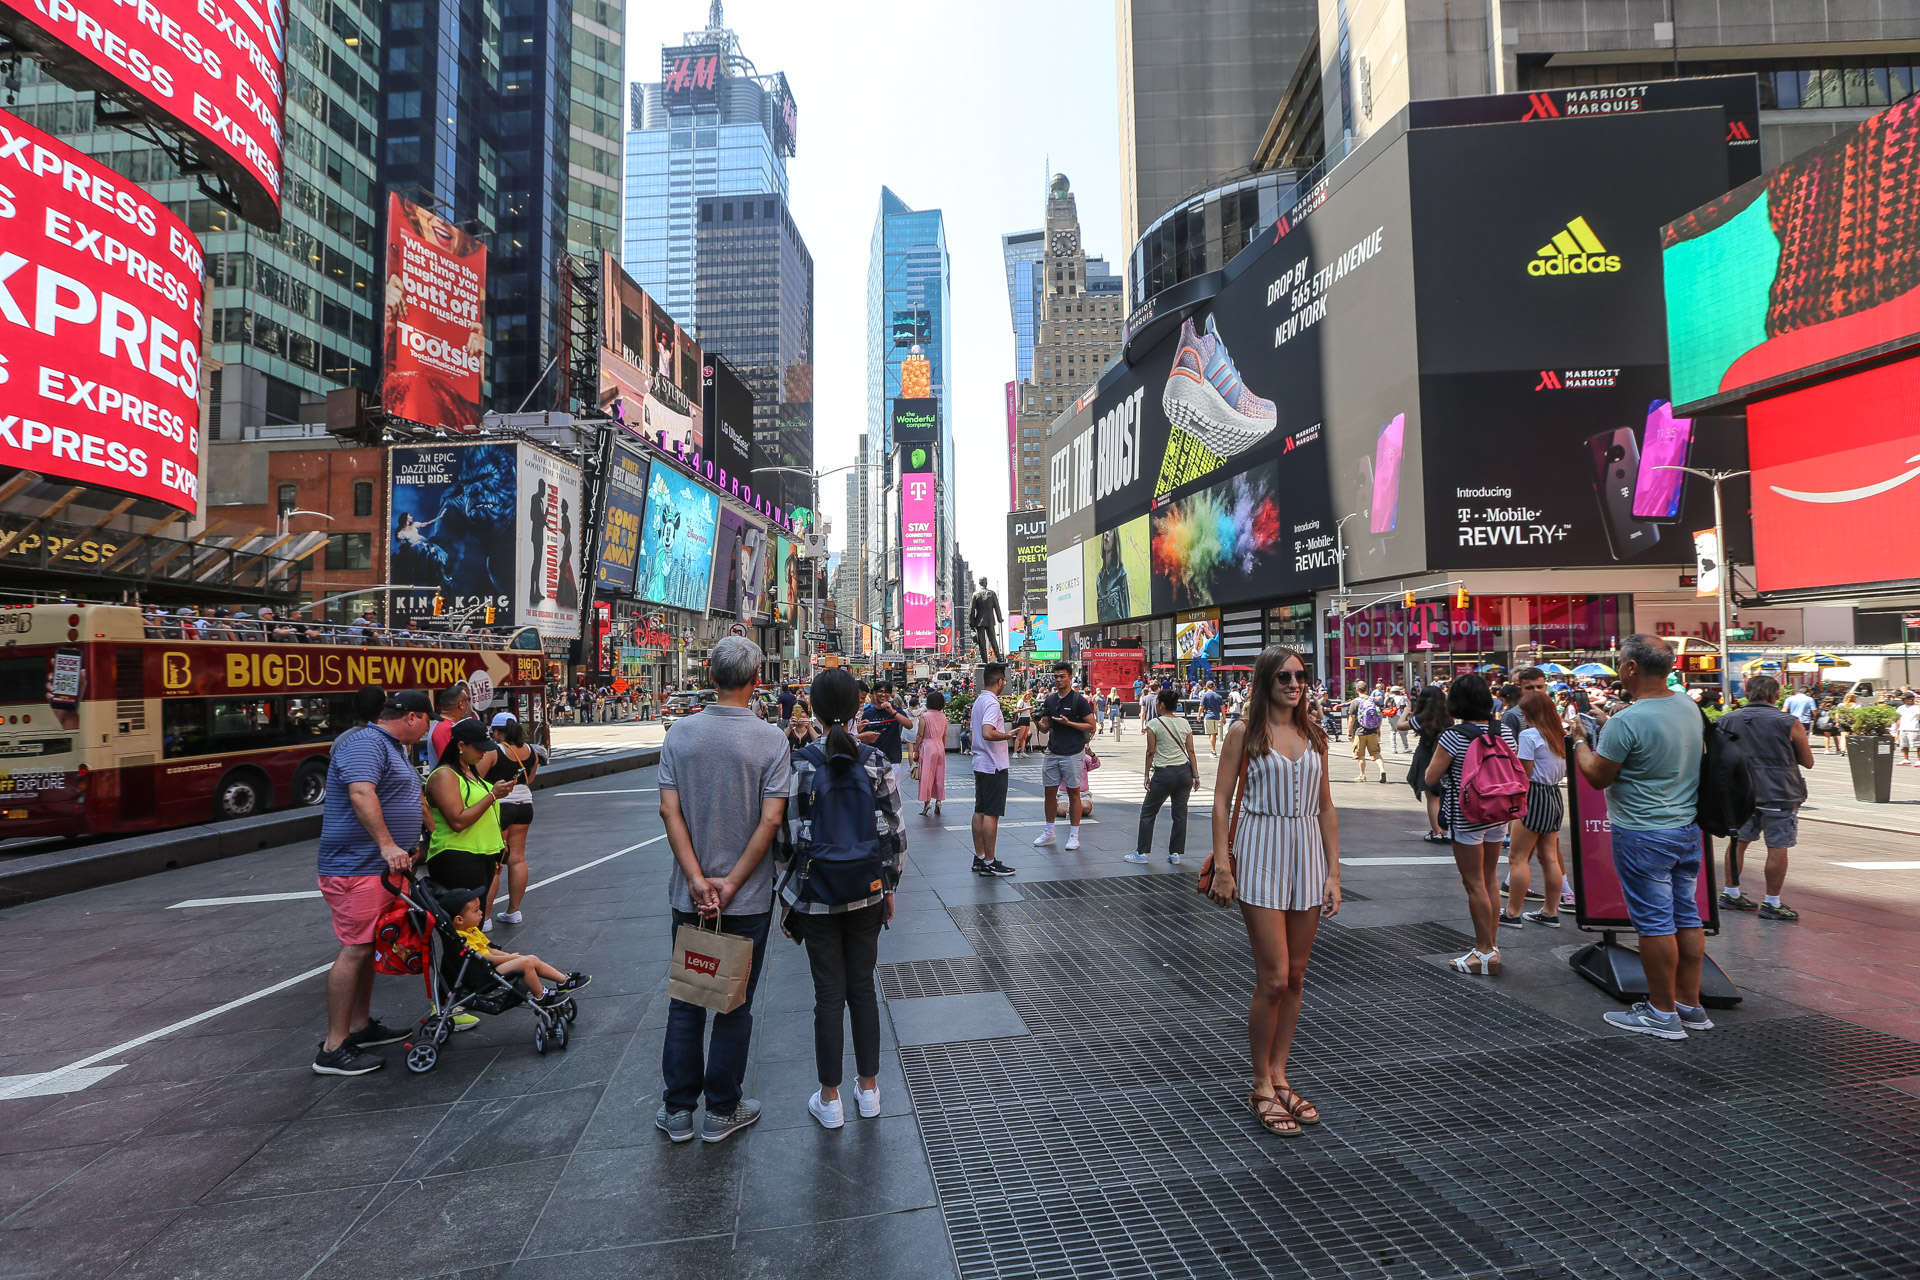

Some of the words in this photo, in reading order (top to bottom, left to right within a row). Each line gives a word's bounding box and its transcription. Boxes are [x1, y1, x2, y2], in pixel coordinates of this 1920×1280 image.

[665, 56, 717, 92] H&M
[1566, 86, 1649, 102] MARRIOTT
[1567, 99, 1640, 115] MARQUIS
[193, 91, 280, 196] EXPRESS
[1292, 177, 1330, 216] MARRIOTT
[1292, 192, 1327, 227] MARQUIS
[45, 206, 188, 310] EXPRESS
[440, 256, 460, 273] was
[462, 266, 478, 282] the
[1292, 280, 1311, 312] 565
[1312, 263, 1334, 298] 5TH
[1334, 226, 1384, 283] AVENUE
[1527, 253, 1621, 276] adidas
[403, 246, 426, 267] last
[430, 260, 456, 281] time
[458, 276, 478, 293] you
[403, 259, 452, 291] laughed
[453, 285, 478, 303] your
[1267, 269, 1293, 307] DROP
[1294, 256, 1309, 286] BY
[402, 272, 447, 308] butt
[450, 299, 478, 321] off
[406, 295, 418, 307] at
[420, 301, 427, 310] a
[1274, 314, 1298, 349] NEW
[1300, 294, 1328, 332] YORK
[397, 321, 480, 373] Tootsie
[623, 344, 653, 379] BROKE
[1566, 369, 1620, 378] MARRIOTT
[1566, 378, 1614, 387] MARQUIS
[39, 365, 184, 443] EXPRESS
[662, 377, 689, 409] STUPID
[722, 420, 729, 435] LG
[896, 415, 936, 423] Wonderful
[1296, 423, 1322, 439] MARRIOTT
[1296, 432, 1319, 446] MARQUIS
[434, 453, 457, 463] EPIC.
[533, 454, 547, 466] HAVE
[548, 460, 552, 468] A
[552, 462, 570, 476] REALLY
[1050, 444, 1071, 526] FEEL
[1074, 425, 1095, 513] THE
[1096, 386, 1144, 501] BOOST
[396, 475, 425, 485] THRILL
[402, 464, 445, 474] DAZZLING
[525, 460, 541, 472] GOOD
[543, 466, 555, 478] TIME
[556, 472, 577, 487] TONIGHT
[613, 464, 625, 481] BEST
[626, 472, 643, 492] MUSICAL
[911, 482, 926, 501] T
[1457, 486, 1512, 499] Introducing
[546, 484, 558, 536] PRETTY
[608, 506, 639, 532] COME
[908, 522, 930, 531] STAY
[1294, 520, 1320, 534] Introducing
[602, 543, 635, 567] AWAY
[1018, 545, 1047, 555] WATCH
[1018, 554, 1036, 564] FREE
[546, 545, 558, 600] WOMAN
[57, 658, 78, 666] BOOK
[347, 656, 404, 685] NEW
[412, 658, 466, 684] YORK
[518, 658, 531, 670] BIG
[56, 673, 77, 683] SAVE
[518, 670, 531, 681] BUS
[56, 682, 76, 693] 10%
[12, 766, 65, 779] DISCOVER
[16, 778, 66, 791] EXPLORE
